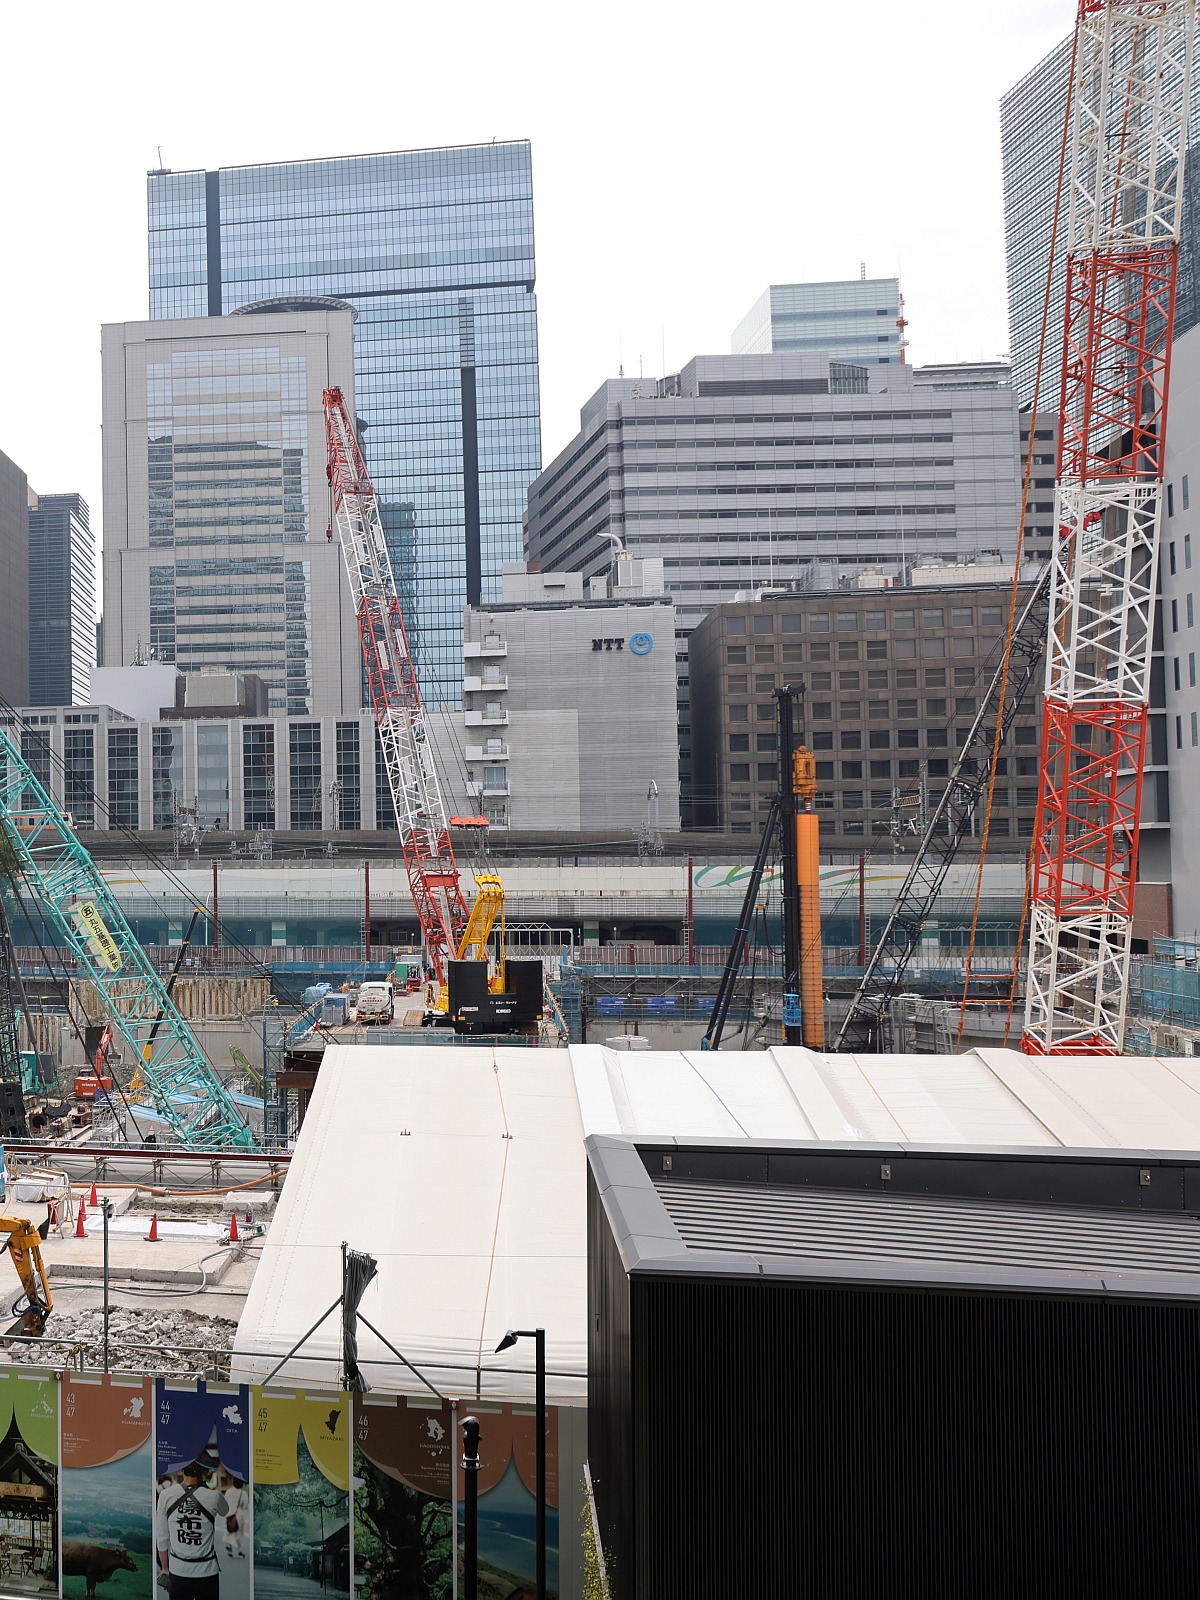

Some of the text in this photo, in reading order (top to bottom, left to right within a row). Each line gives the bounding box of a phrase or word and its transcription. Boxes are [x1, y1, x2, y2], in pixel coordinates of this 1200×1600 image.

[592, 638, 624, 650] NTT
[66, 1393, 76, 1403] 43
[161, 1401, 170, 1410] 44
[66, 1407, 76, 1417] 47
[258, 1408, 268, 1418] 45
[161, 1415, 170, 1425] 47
[359, 1416, 368, 1426] 46
[258, 1422, 268, 1432] 47
[359, 1430, 368, 1440] 47
